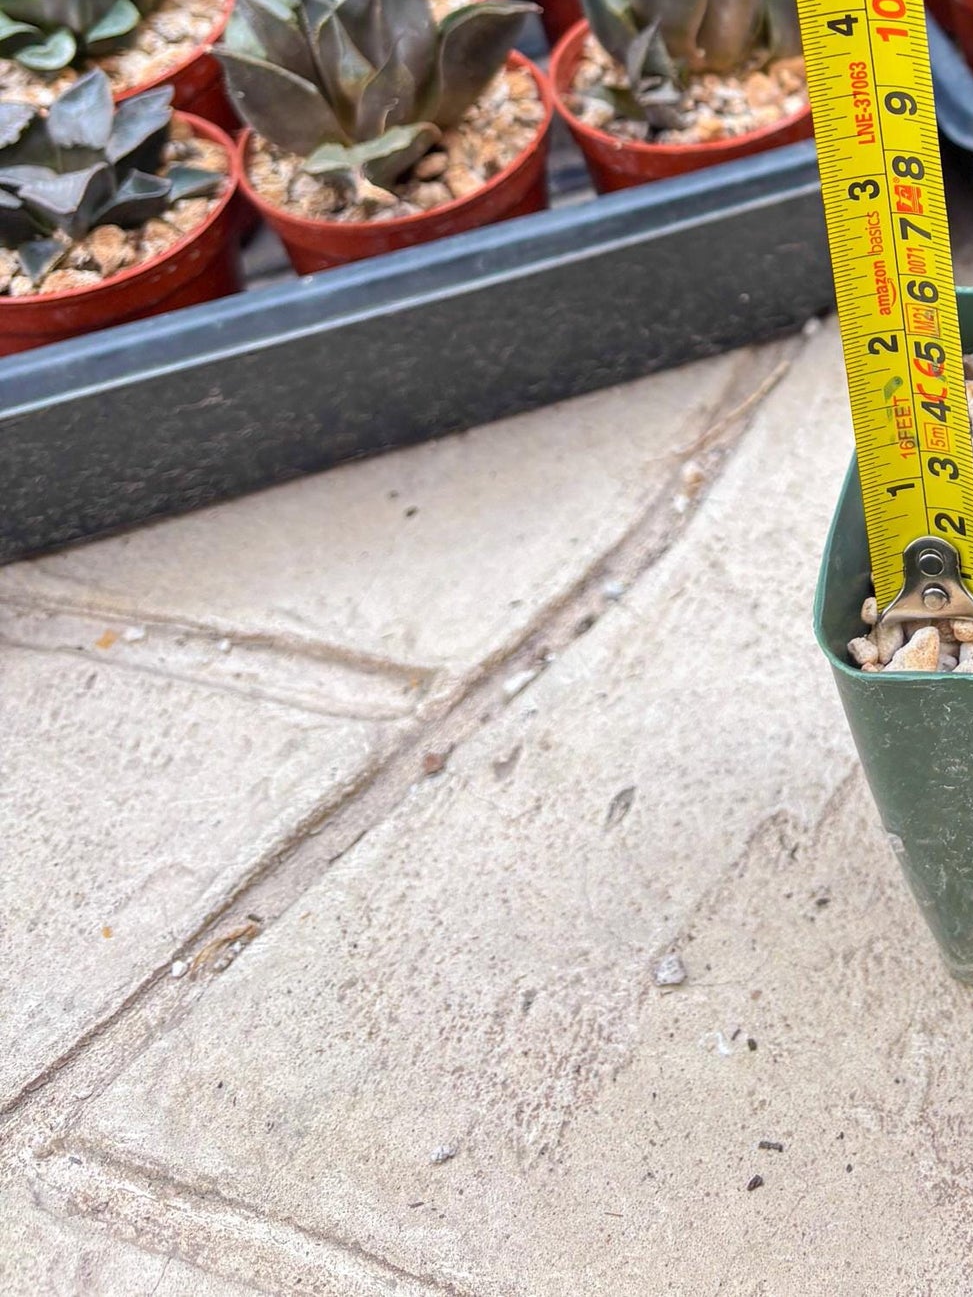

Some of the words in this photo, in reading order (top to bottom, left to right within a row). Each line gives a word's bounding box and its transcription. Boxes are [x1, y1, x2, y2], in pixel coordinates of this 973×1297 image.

[827, 14, 858, 36] 4
[849, 61, 876, 145] LNE-37063
[885, 91, 918, 115] 9
[892, 155, 925, 181] 8
[848, 179, 880, 201] 3
[865, 210, 884, 256] basics
[899, 217, 932, 240] 7
[906, 247, 927, 275] 0071
[873, 260, 892, 316] amazon
[907, 280, 939, 304] 6
[913, 307, 935, 337] M21
[868, 334, 899, 355] 2
[914, 341, 946, 364] 5
[921, 399, 951, 423] 4
[893, 396, 916, 460] 16FEET
[931, 427, 946, 448] 5m
[928, 456, 960, 481] 3
[887, 483, 915, 497] 1
[934, 512, 967, 536] 2
